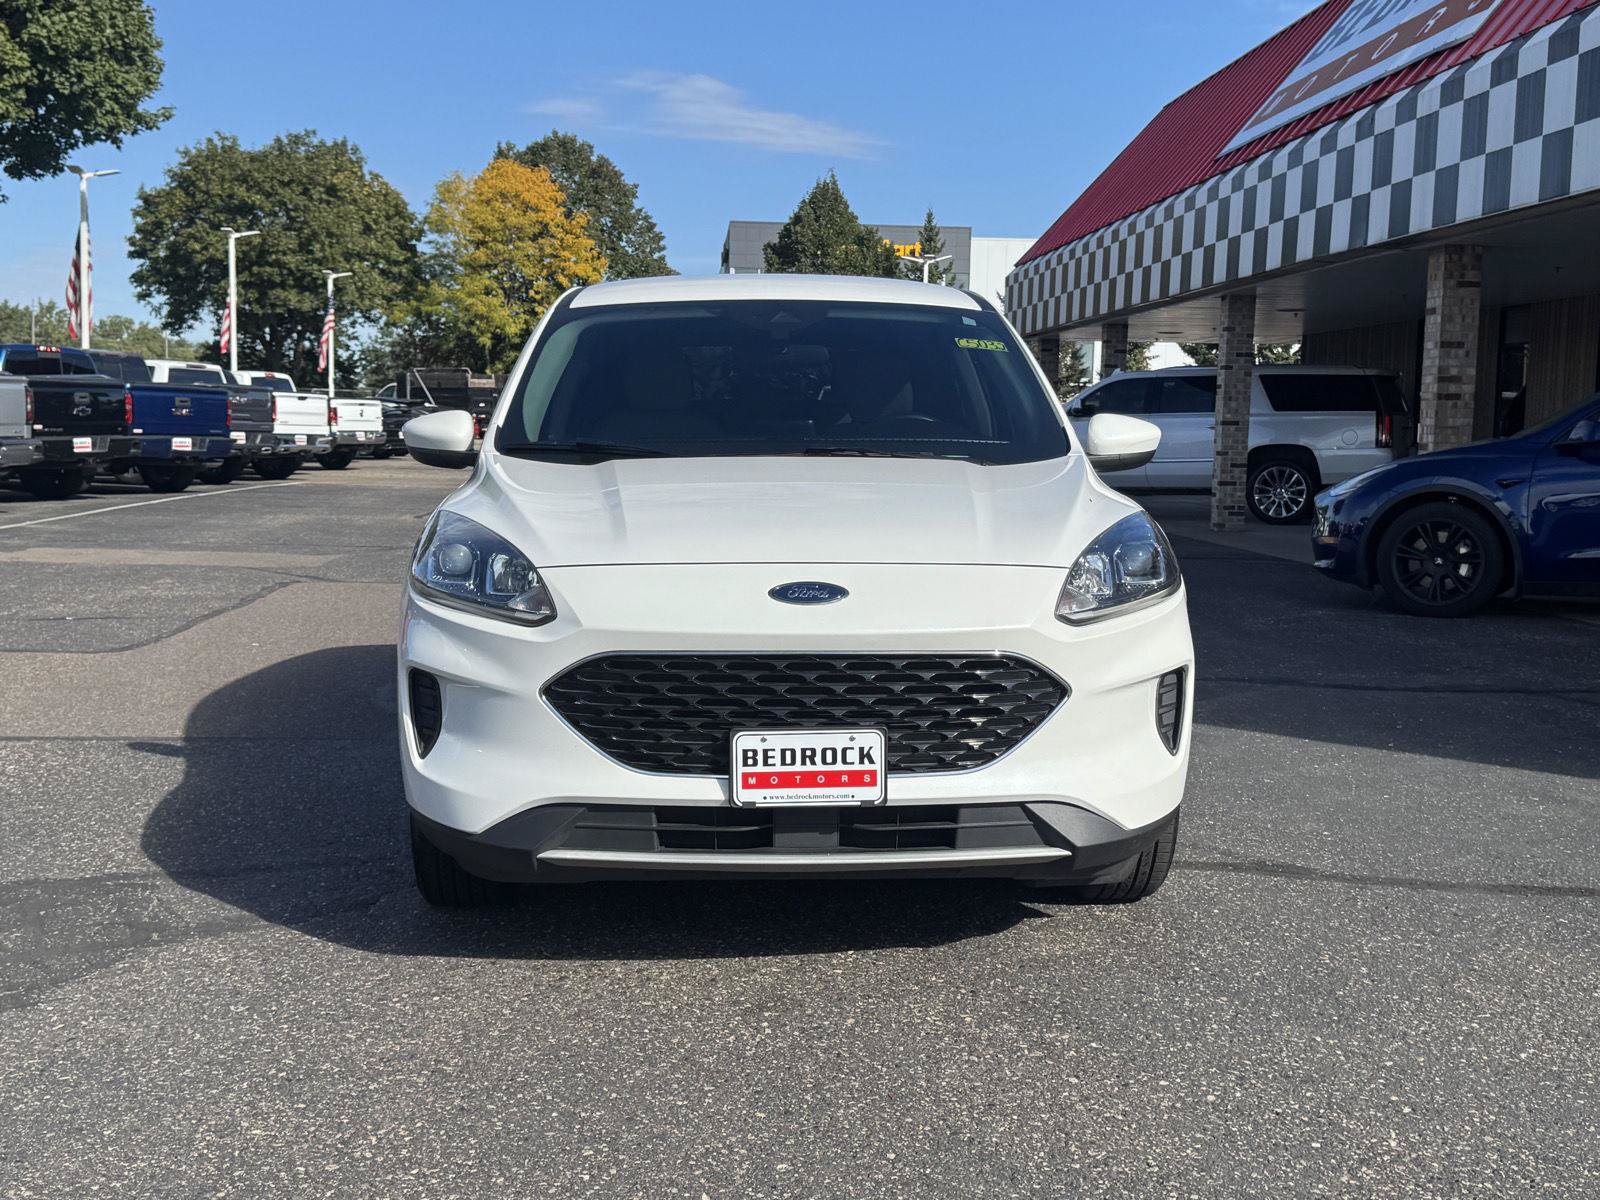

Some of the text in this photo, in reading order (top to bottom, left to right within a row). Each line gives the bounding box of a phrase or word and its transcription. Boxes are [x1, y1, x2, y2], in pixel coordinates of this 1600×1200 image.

[787, 584, 830, 598] Ford
[742, 746, 876, 768] BEDROCK
[748, 774, 871, 785] MOTORS
[768, 793, 850, 801] www.bedrockmotors.com
